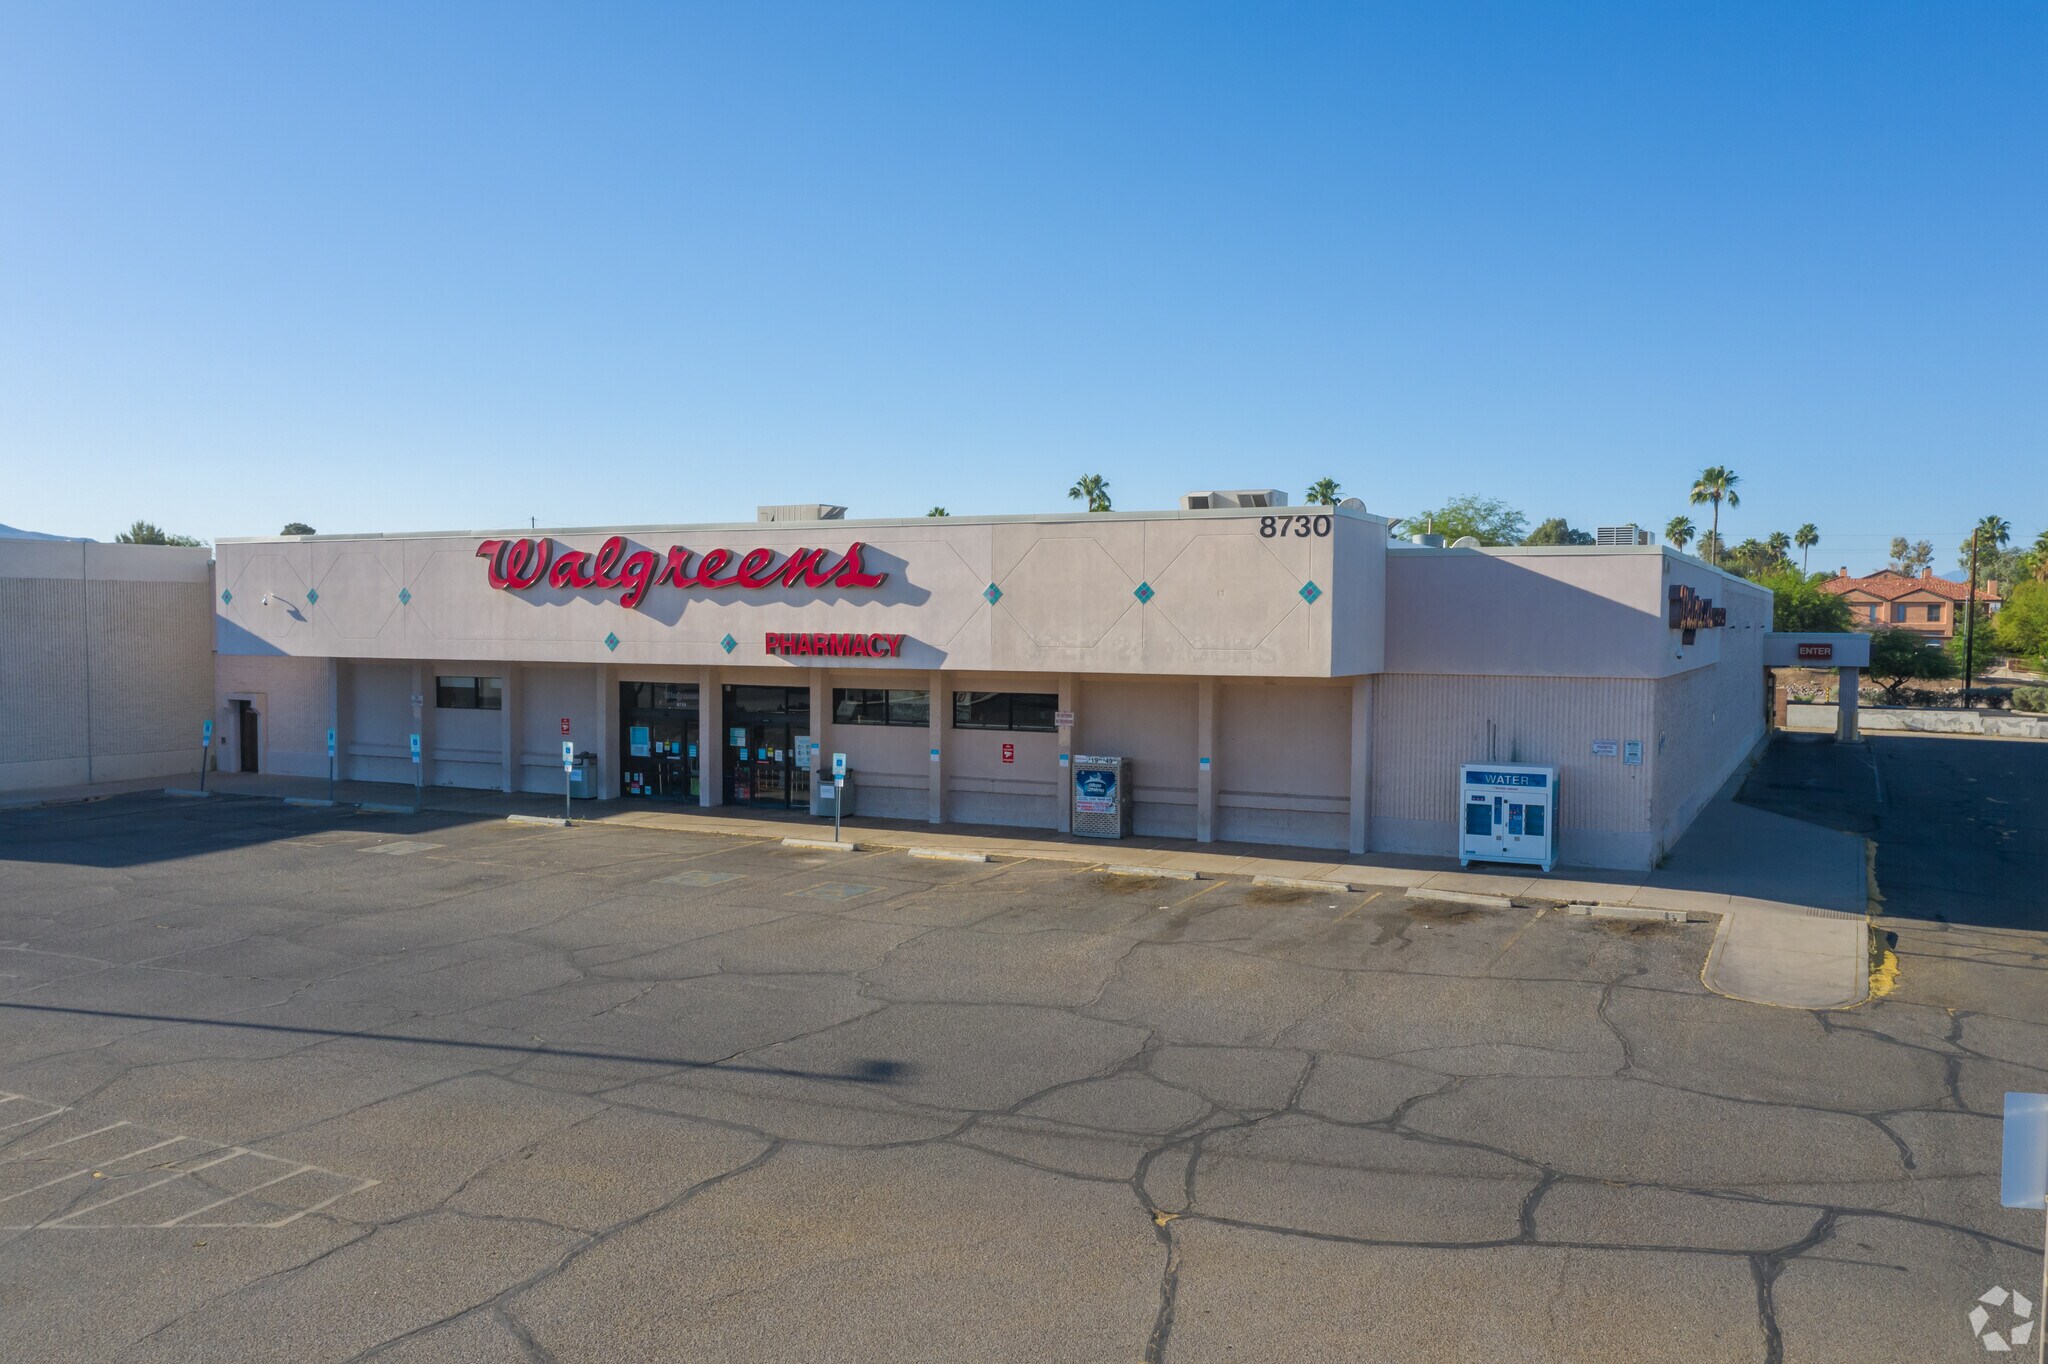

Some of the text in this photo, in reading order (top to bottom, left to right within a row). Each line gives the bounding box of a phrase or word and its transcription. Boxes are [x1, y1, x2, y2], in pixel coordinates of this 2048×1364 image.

[1260, 515, 1332, 538] 8730
[476, 536, 889, 608] Walgreens
[766, 632, 906, 657] PHARMACY
[1799, 647, 1831, 655] ENTER
[1485, 774, 1529, 786] WATER
